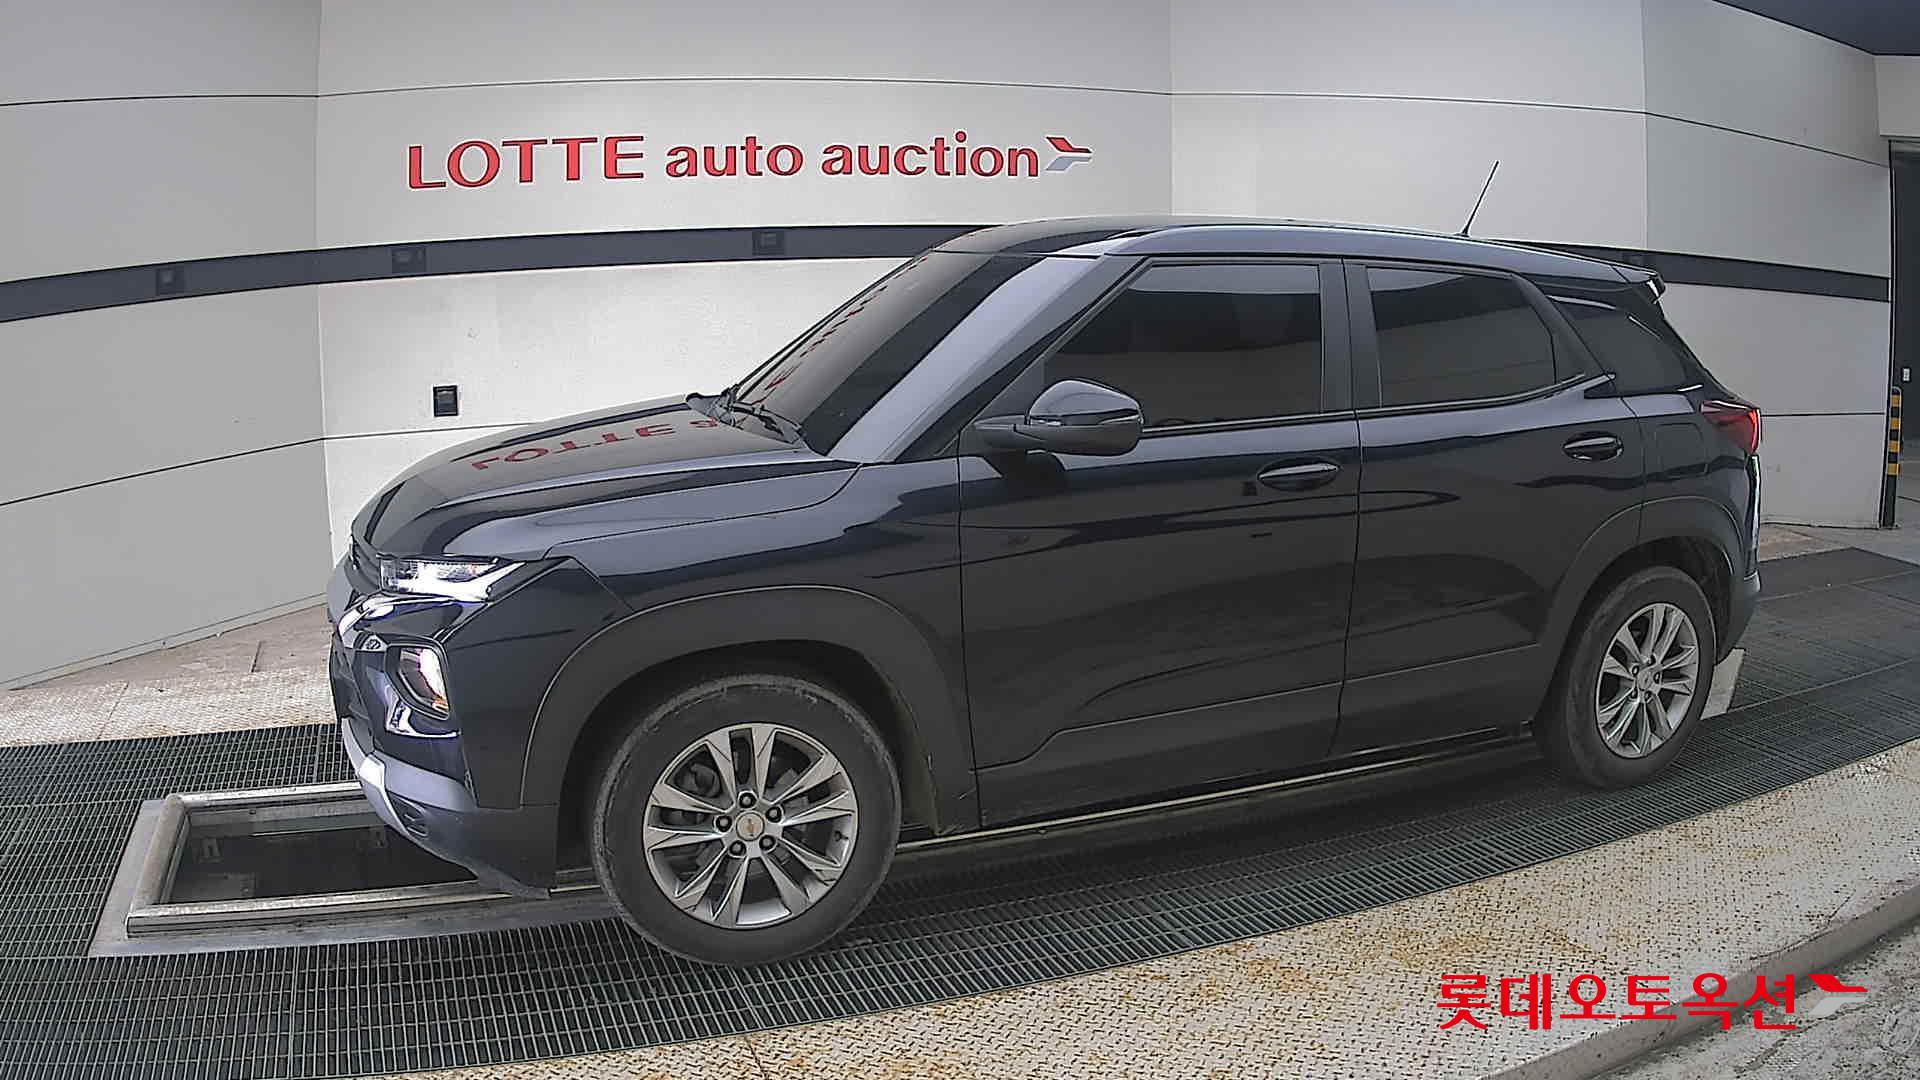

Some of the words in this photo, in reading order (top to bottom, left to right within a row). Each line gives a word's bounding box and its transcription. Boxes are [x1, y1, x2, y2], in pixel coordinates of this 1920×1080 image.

[408, 135, 644, 189] LOTTE
[665, 135, 804, 177] auto
[821, 130, 1039, 177] auction
